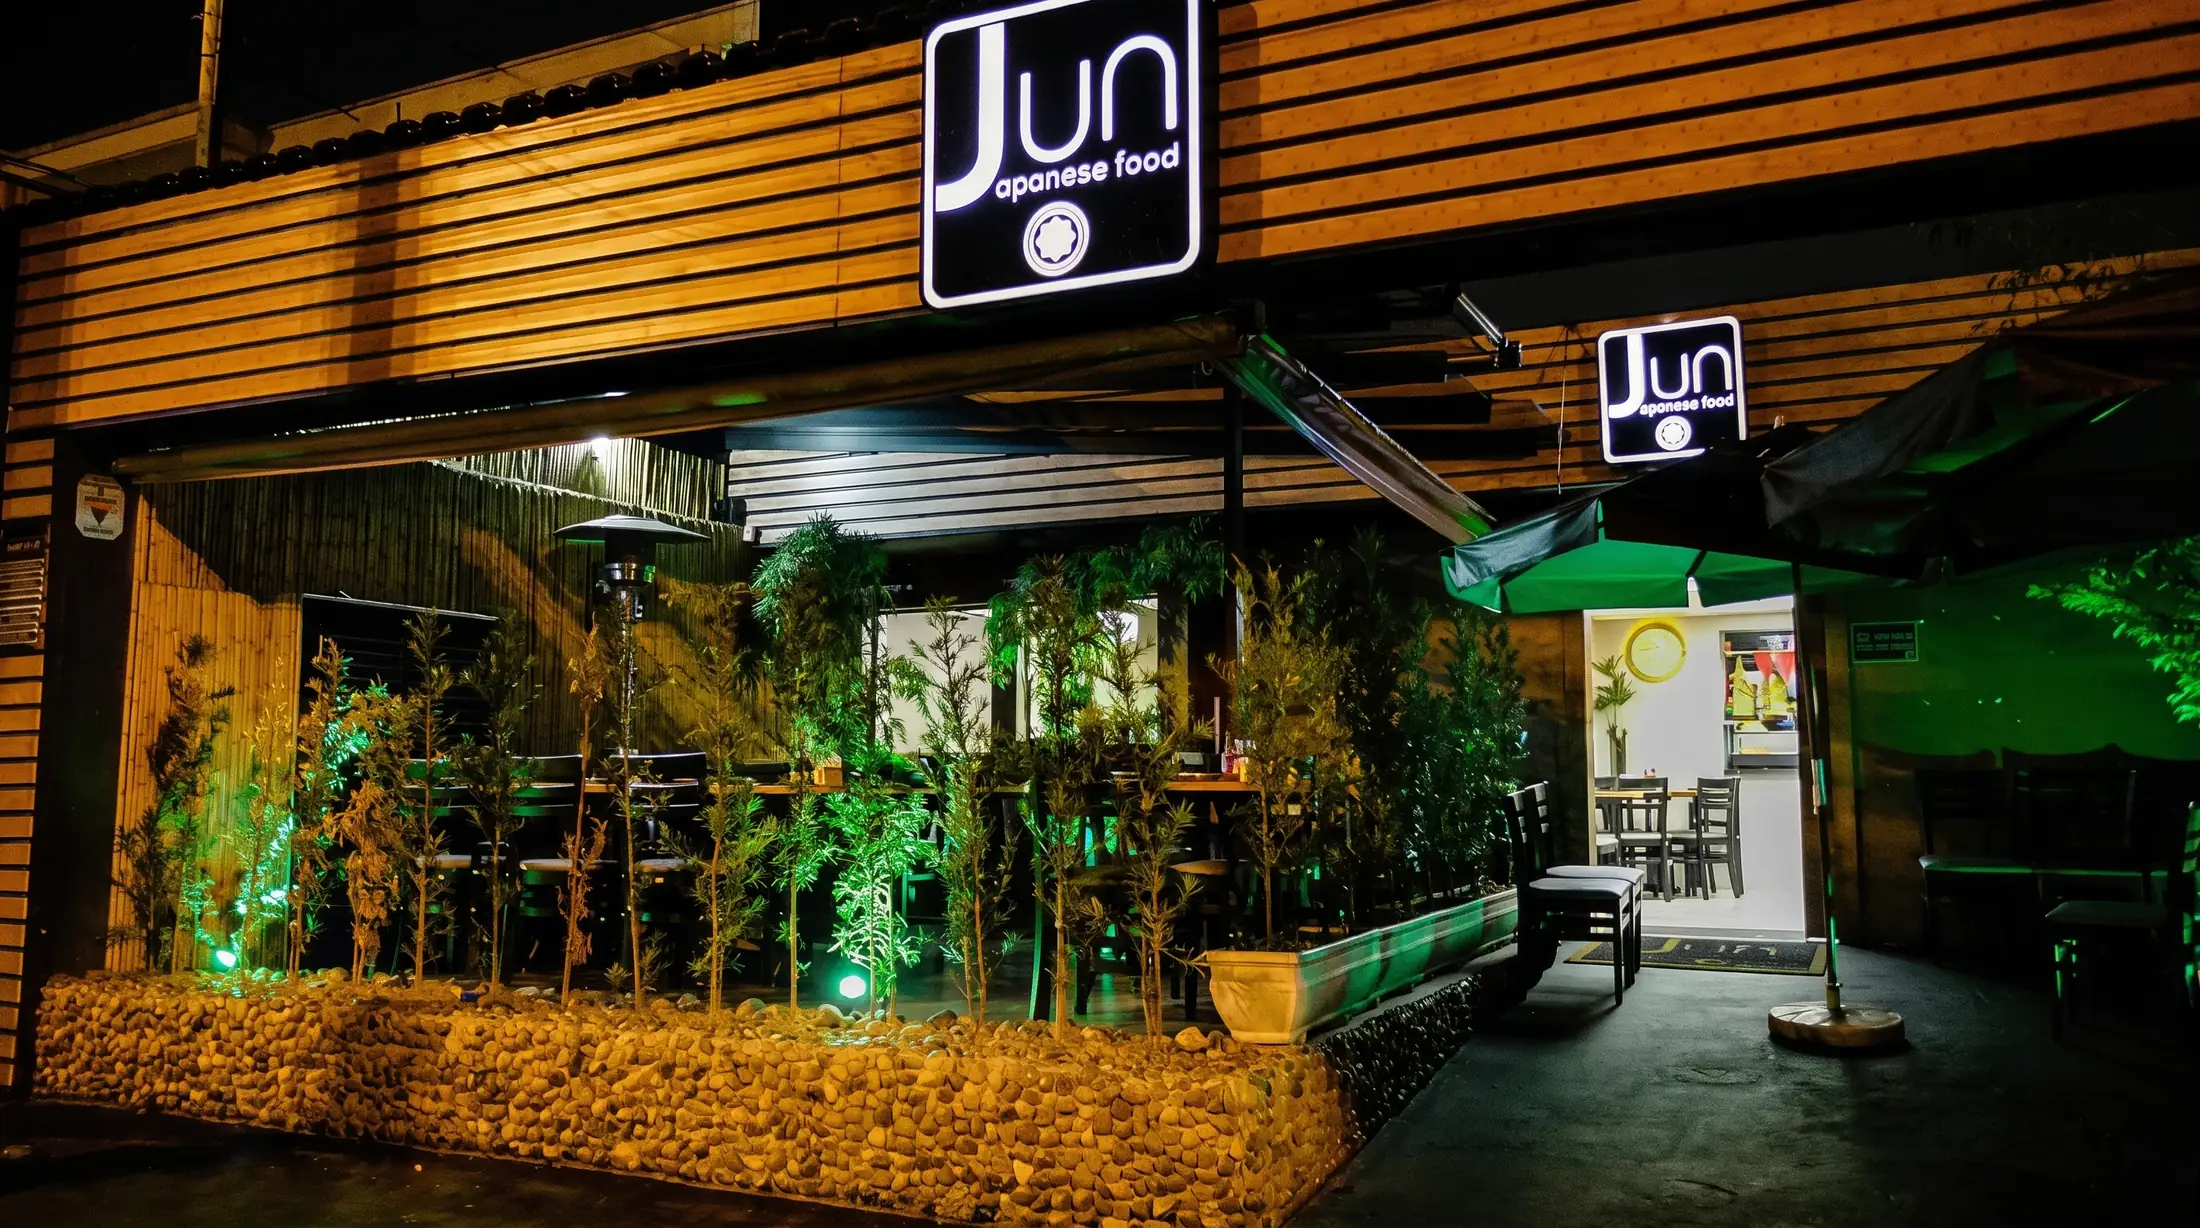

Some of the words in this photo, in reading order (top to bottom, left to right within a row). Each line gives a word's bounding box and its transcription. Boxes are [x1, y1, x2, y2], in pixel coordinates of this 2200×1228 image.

[935, 21, 1178, 213] Jun
[995, 161, 1109, 204] apanese
[1114, 141, 1180, 178] food
[1608, 333, 1733, 419] Jun
[1701, 393, 1734, 409] food
